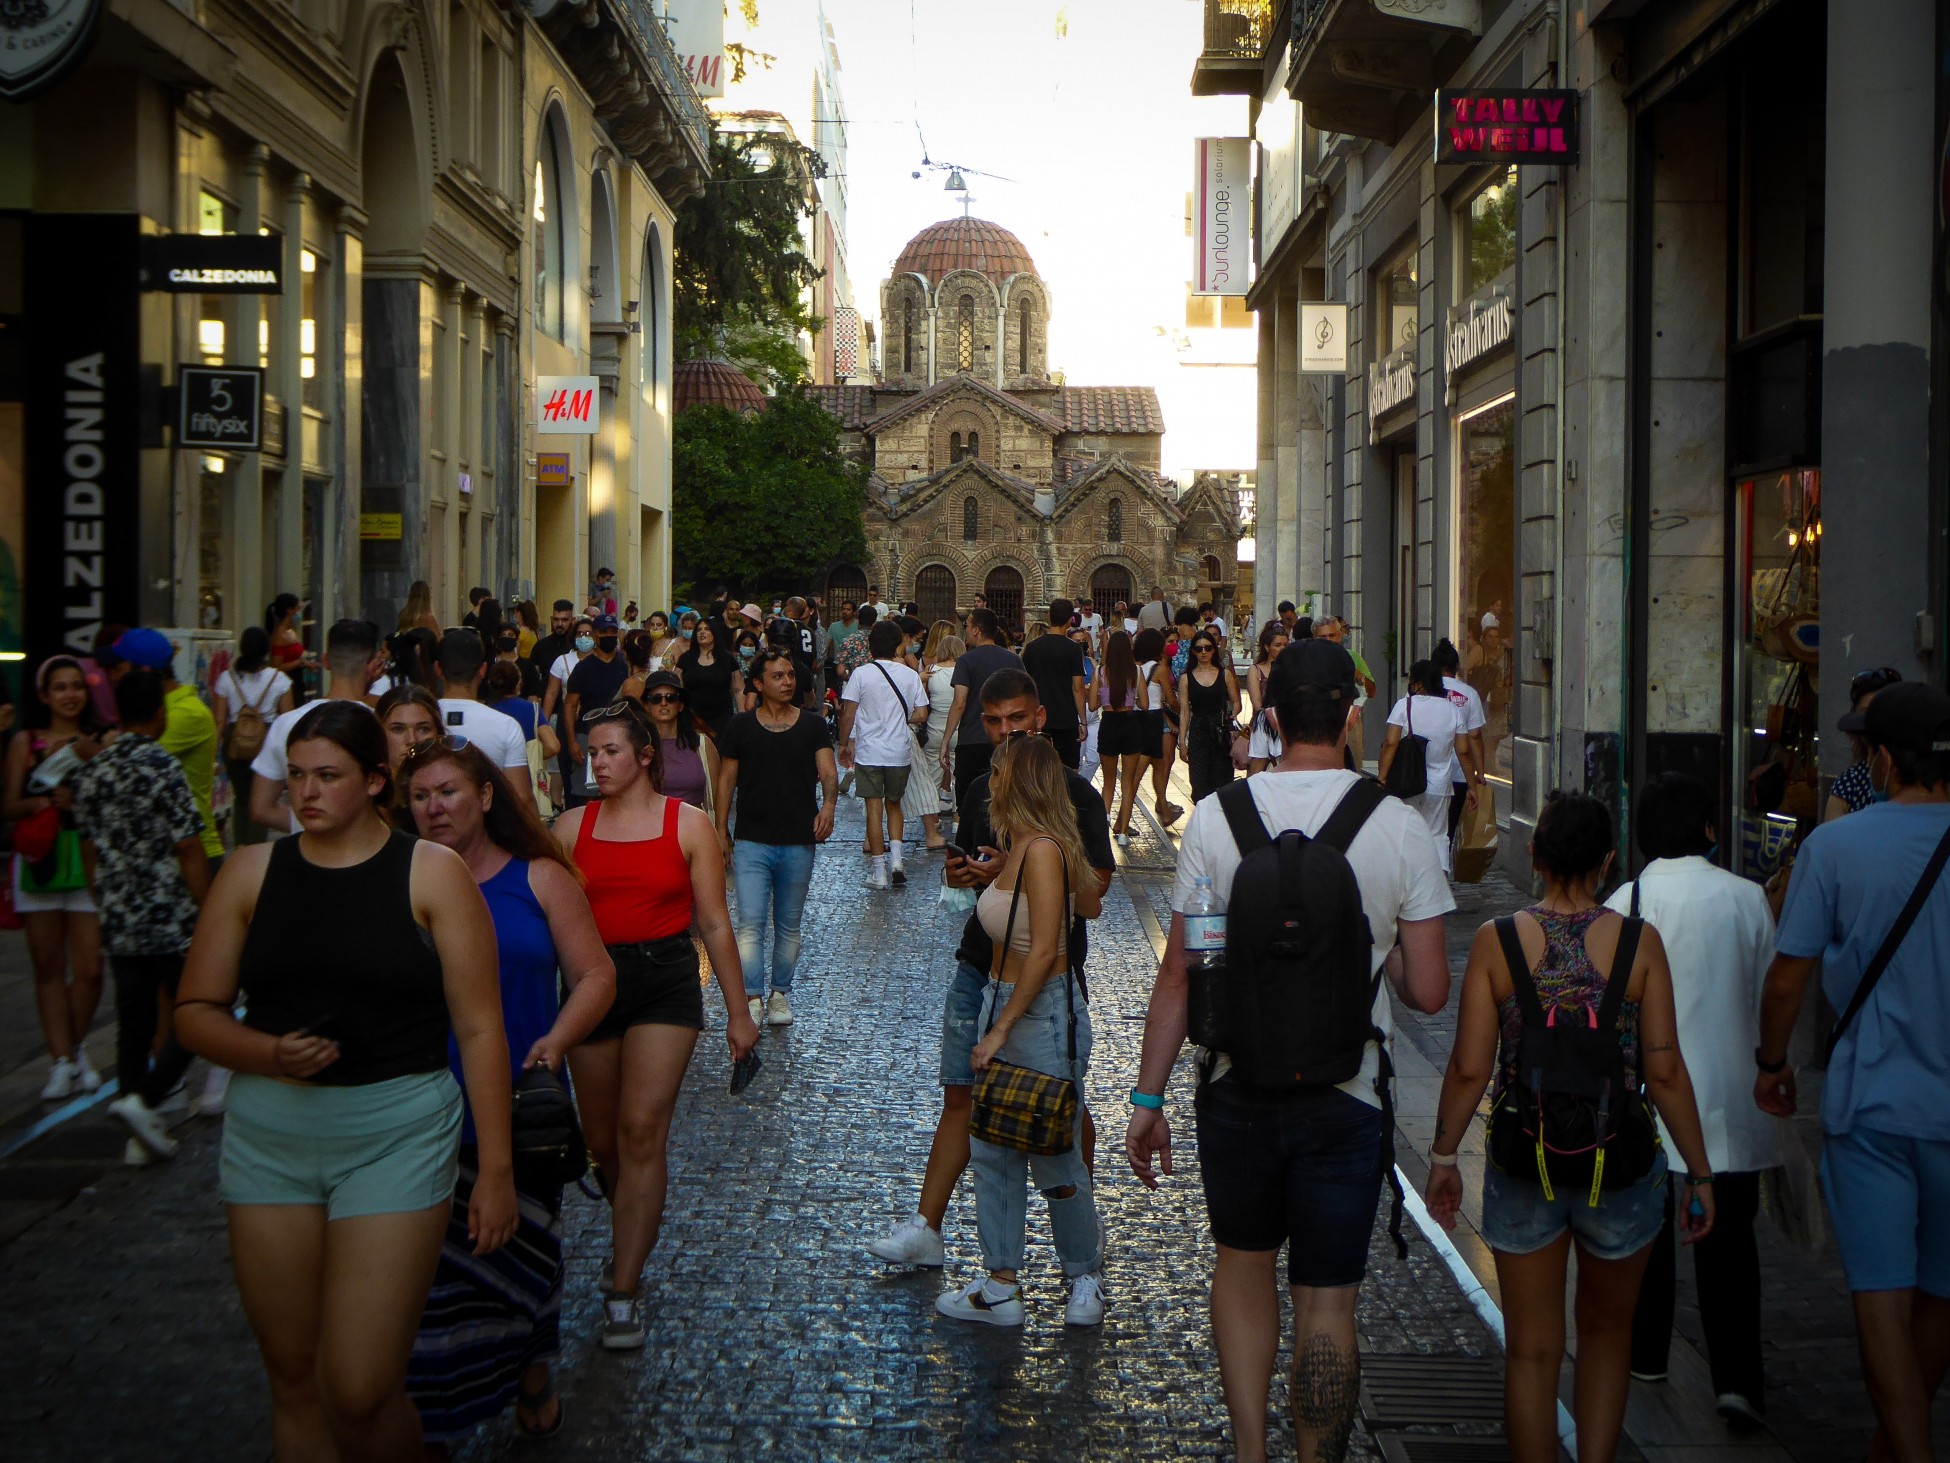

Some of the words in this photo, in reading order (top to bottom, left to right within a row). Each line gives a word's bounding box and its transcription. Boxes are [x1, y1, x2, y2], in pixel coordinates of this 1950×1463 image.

[1450, 98, 1565, 123] TALLY
[168, 268, 277, 284] CALZEDONIA
[543, 389, 593, 422] H&M
[191, 412, 249, 437] fiftysix
[541, 464, 566, 474] ATM
[64, 351, 105, 654] ALZEDONIA
[801, 629, 813, 652] 2
